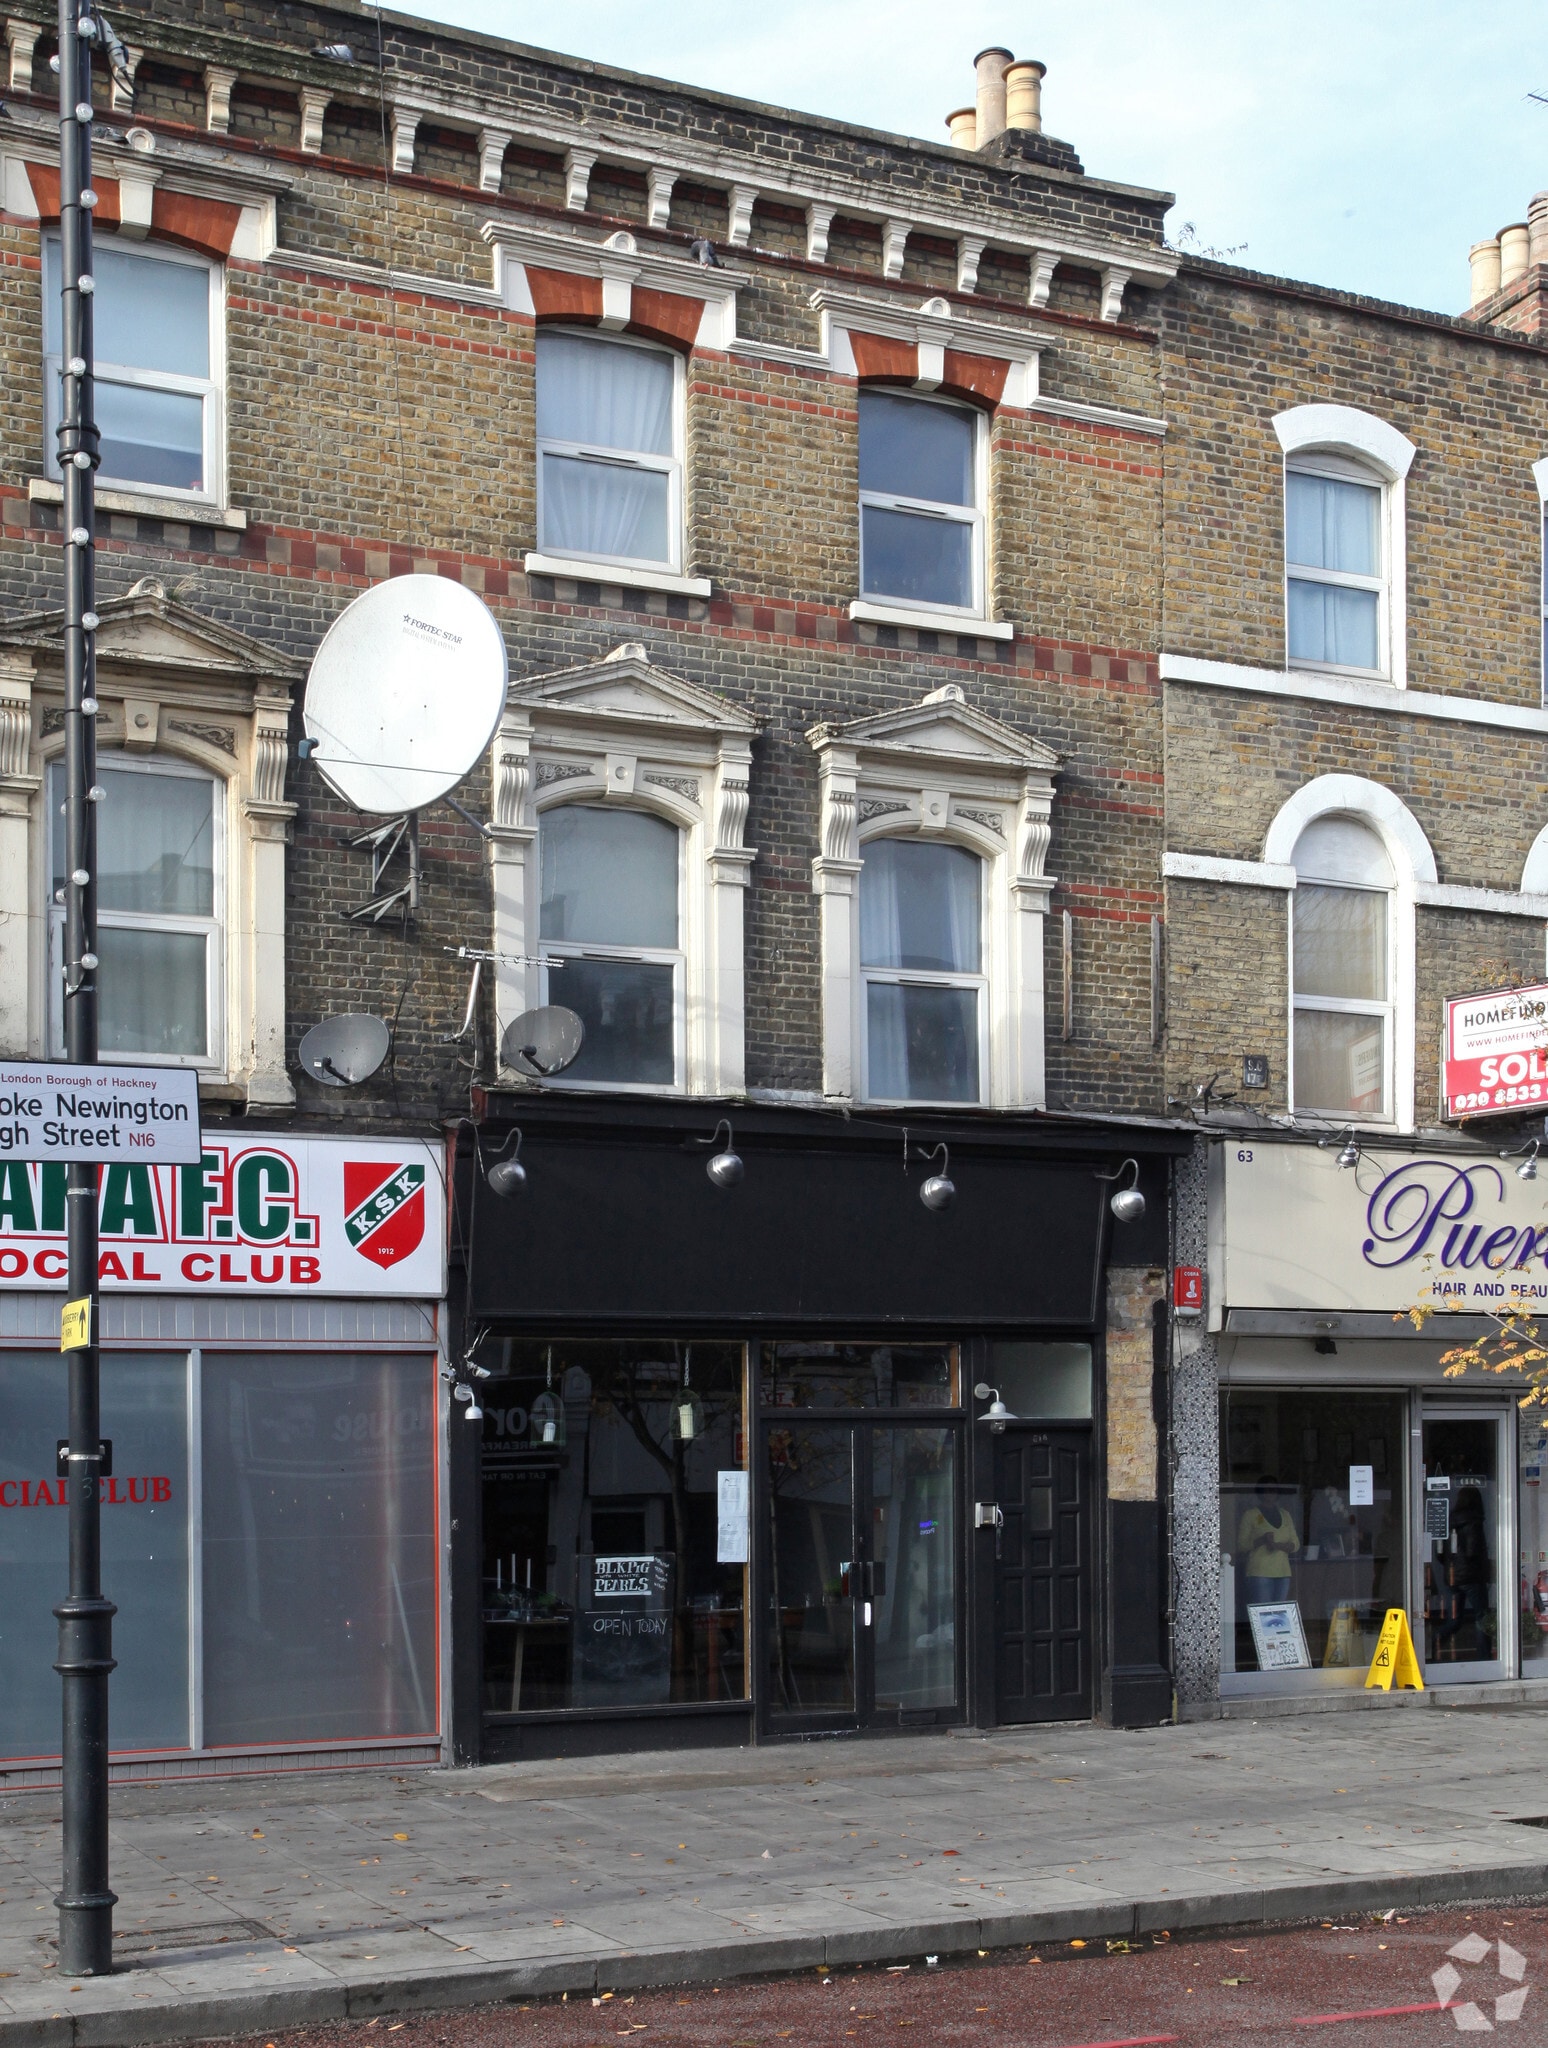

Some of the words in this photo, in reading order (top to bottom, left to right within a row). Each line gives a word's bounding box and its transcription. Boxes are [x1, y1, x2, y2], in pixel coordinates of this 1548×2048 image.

[410, 618, 442, 636] FORTEC
[442, 631, 463, 645] STAR
[1480, 1053, 1548, 1089] SOL
[1, 1073, 42, 1084] London
[46, 1075, 92, 1087] Borough
[96, 1077, 107, 1087] of
[112, 1078, 157, 1090] Hackney
[0, 1092, 43, 1117] oke
[56, 1093, 188, 1125] Newington
[1455, 1091, 1490, 1109] 020
[0, 1121, 29, 1150] gh
[43, 1121, 120, 1147] Street
[129, 1133, 156, 1147] N16
[1237, 1150, 1254, 1163] 63
[351, 1170, 419, 1236] K.S.K
[378, 1247, 395, 1255] 1912
[0, 1248, 162, 1282] OCAL
[180, 1252, 322, 1284] CLUB
[1432, 1282, 1467, 1297] HAIR
[1473, 1282, 1505, 1297] AND
[593, 1577, 649, 1592] PEARLS
[593, 1618, 632, 1637] OPEN
[635, 1617, 668, 1635] TODAY
